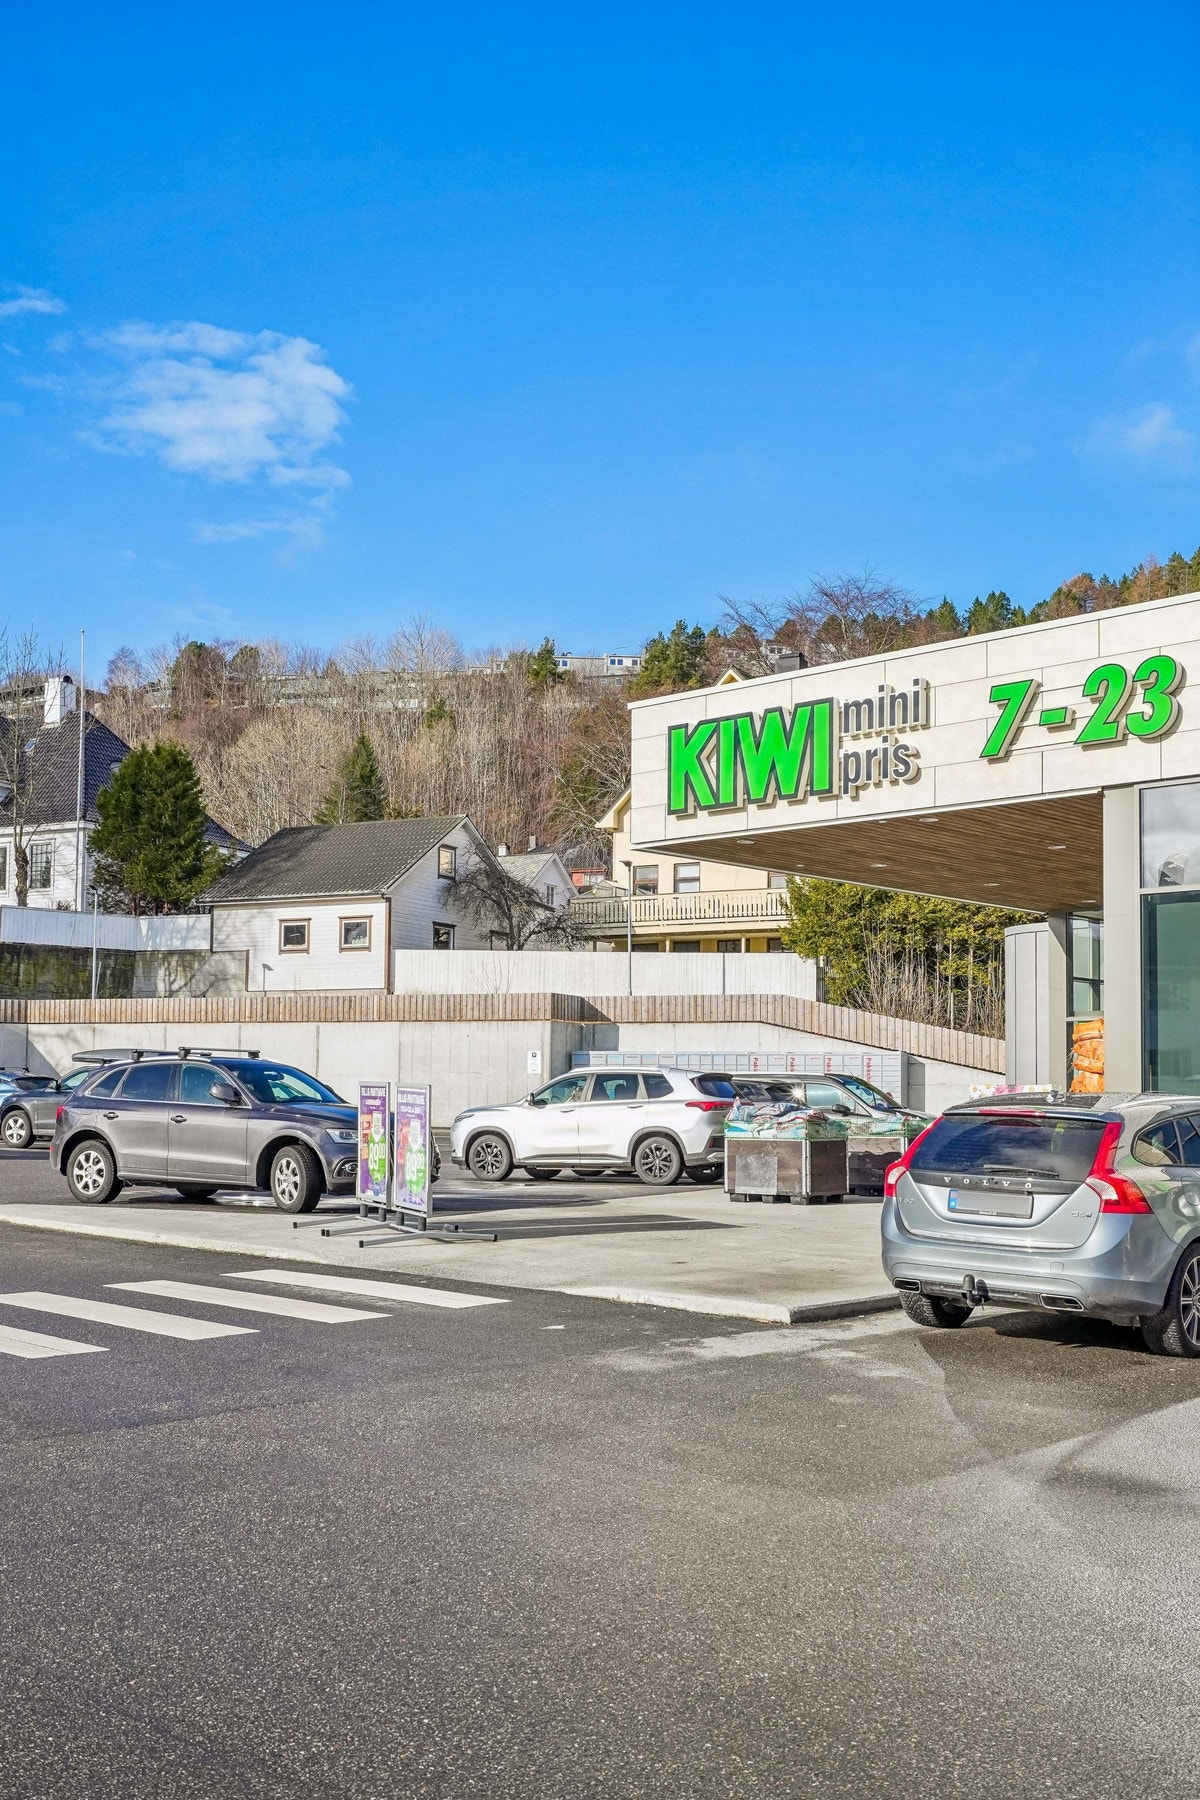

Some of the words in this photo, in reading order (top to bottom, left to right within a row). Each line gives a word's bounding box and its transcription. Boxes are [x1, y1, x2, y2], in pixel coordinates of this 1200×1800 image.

[843, 678, 921, 734] mini
[668, 697, 834, 815] KIWI
[842, 735, 911, 795] pris
[943, 1176, 1032, 1189] VOLVO
